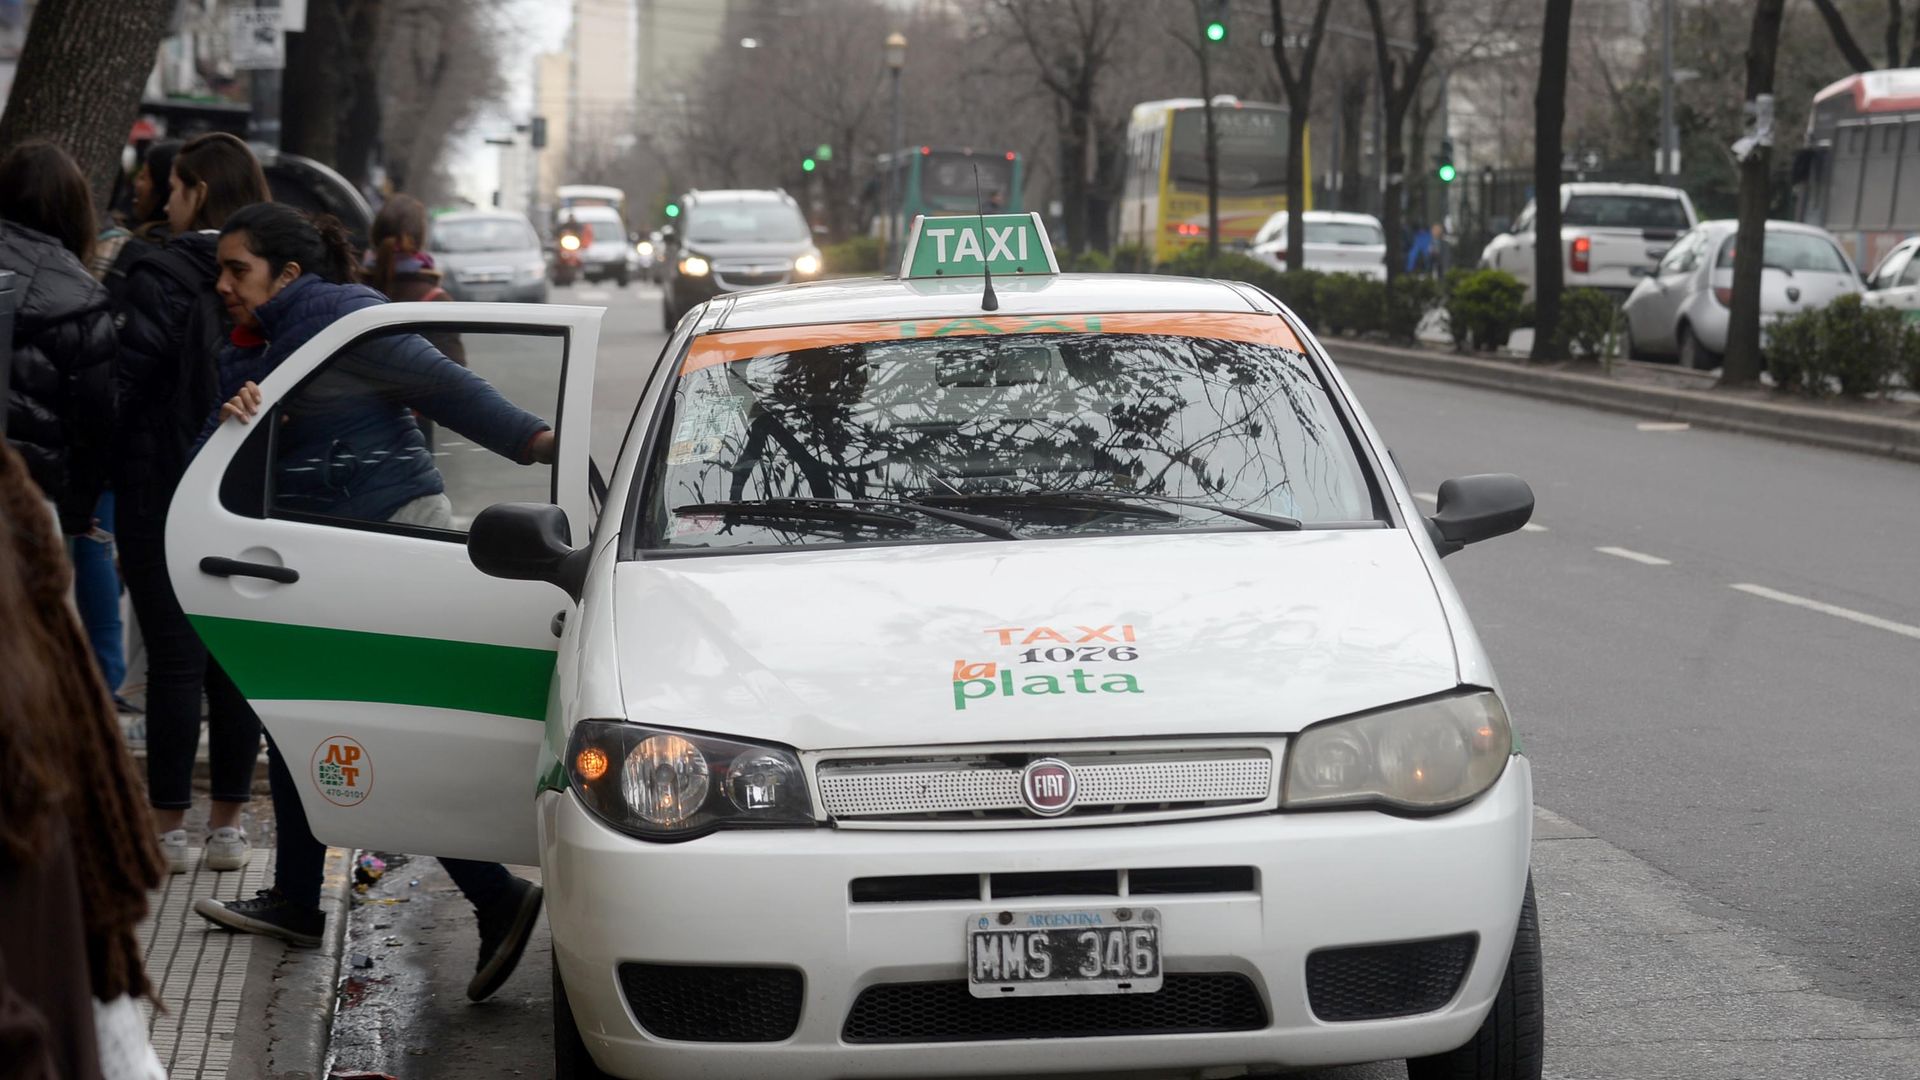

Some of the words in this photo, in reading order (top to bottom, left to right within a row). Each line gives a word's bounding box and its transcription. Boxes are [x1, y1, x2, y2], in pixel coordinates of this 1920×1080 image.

[927, 226, 1027, 262] TAXI
[984, 625, 1136, 645] TAXI
[1019, 646, 1139, 664] 1076
[953, 660, 997, 680] la
[953, 669, 1144, 710] plata
[1034, 775, 1064, 797] FIAT
[1028, 913, 1102, 926] ARGENTINA
[977, 934, 1051, 980] MMS
[1078, 930, 1153, 976] 346
